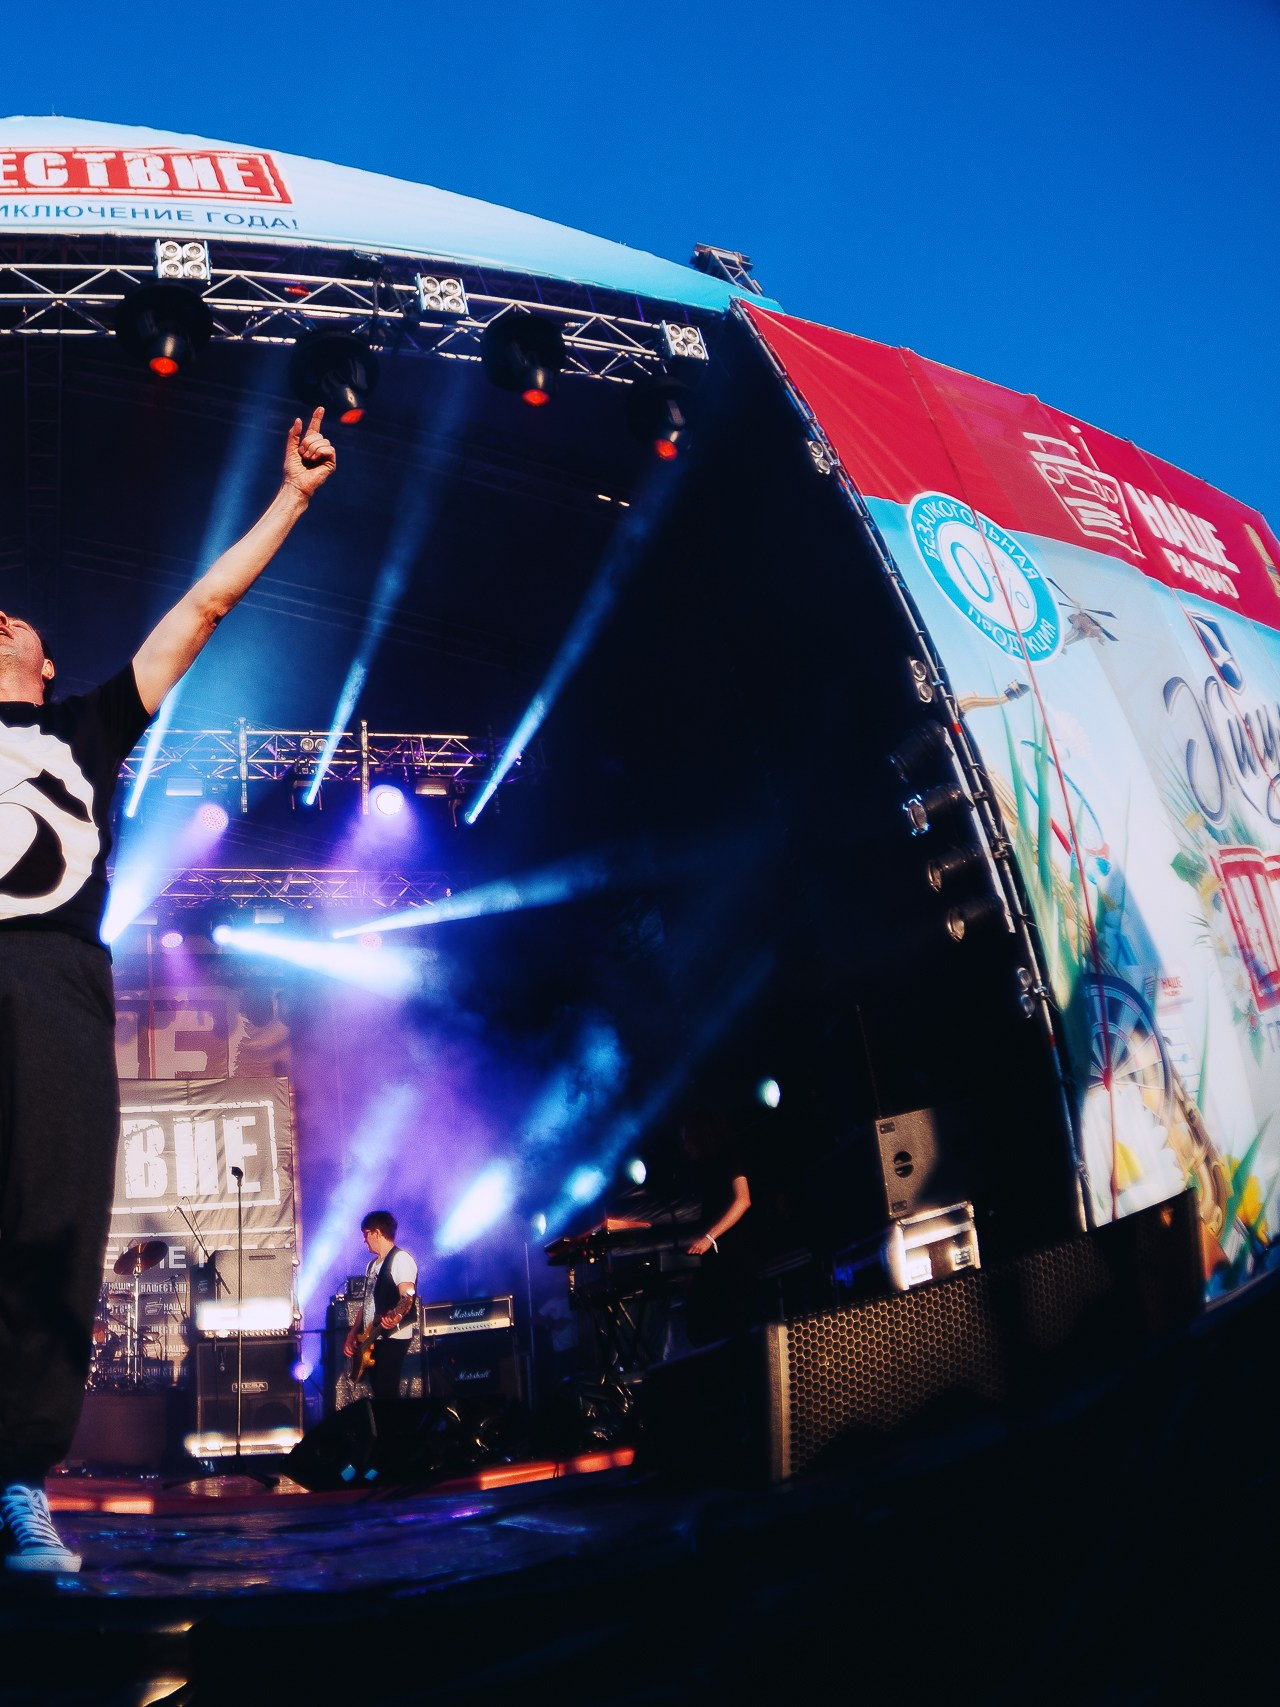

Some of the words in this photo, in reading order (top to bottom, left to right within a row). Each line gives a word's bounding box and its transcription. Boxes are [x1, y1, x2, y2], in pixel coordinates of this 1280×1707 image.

[206, 211, 299, 230] ГОДА!
[916, 500, 1040, 580] БЕЗАЛКОГОЛЬНАЯ
[1123, 481, 1240, 574] НАШЕ
[1162, 547, 1240, 600] РАДИО
[968, 606, 1057, 657] ПРОДКЦИЯ
[450, 1308, 486, 1320] Marshall
[458, 1370, 491, 1381] Marshall
